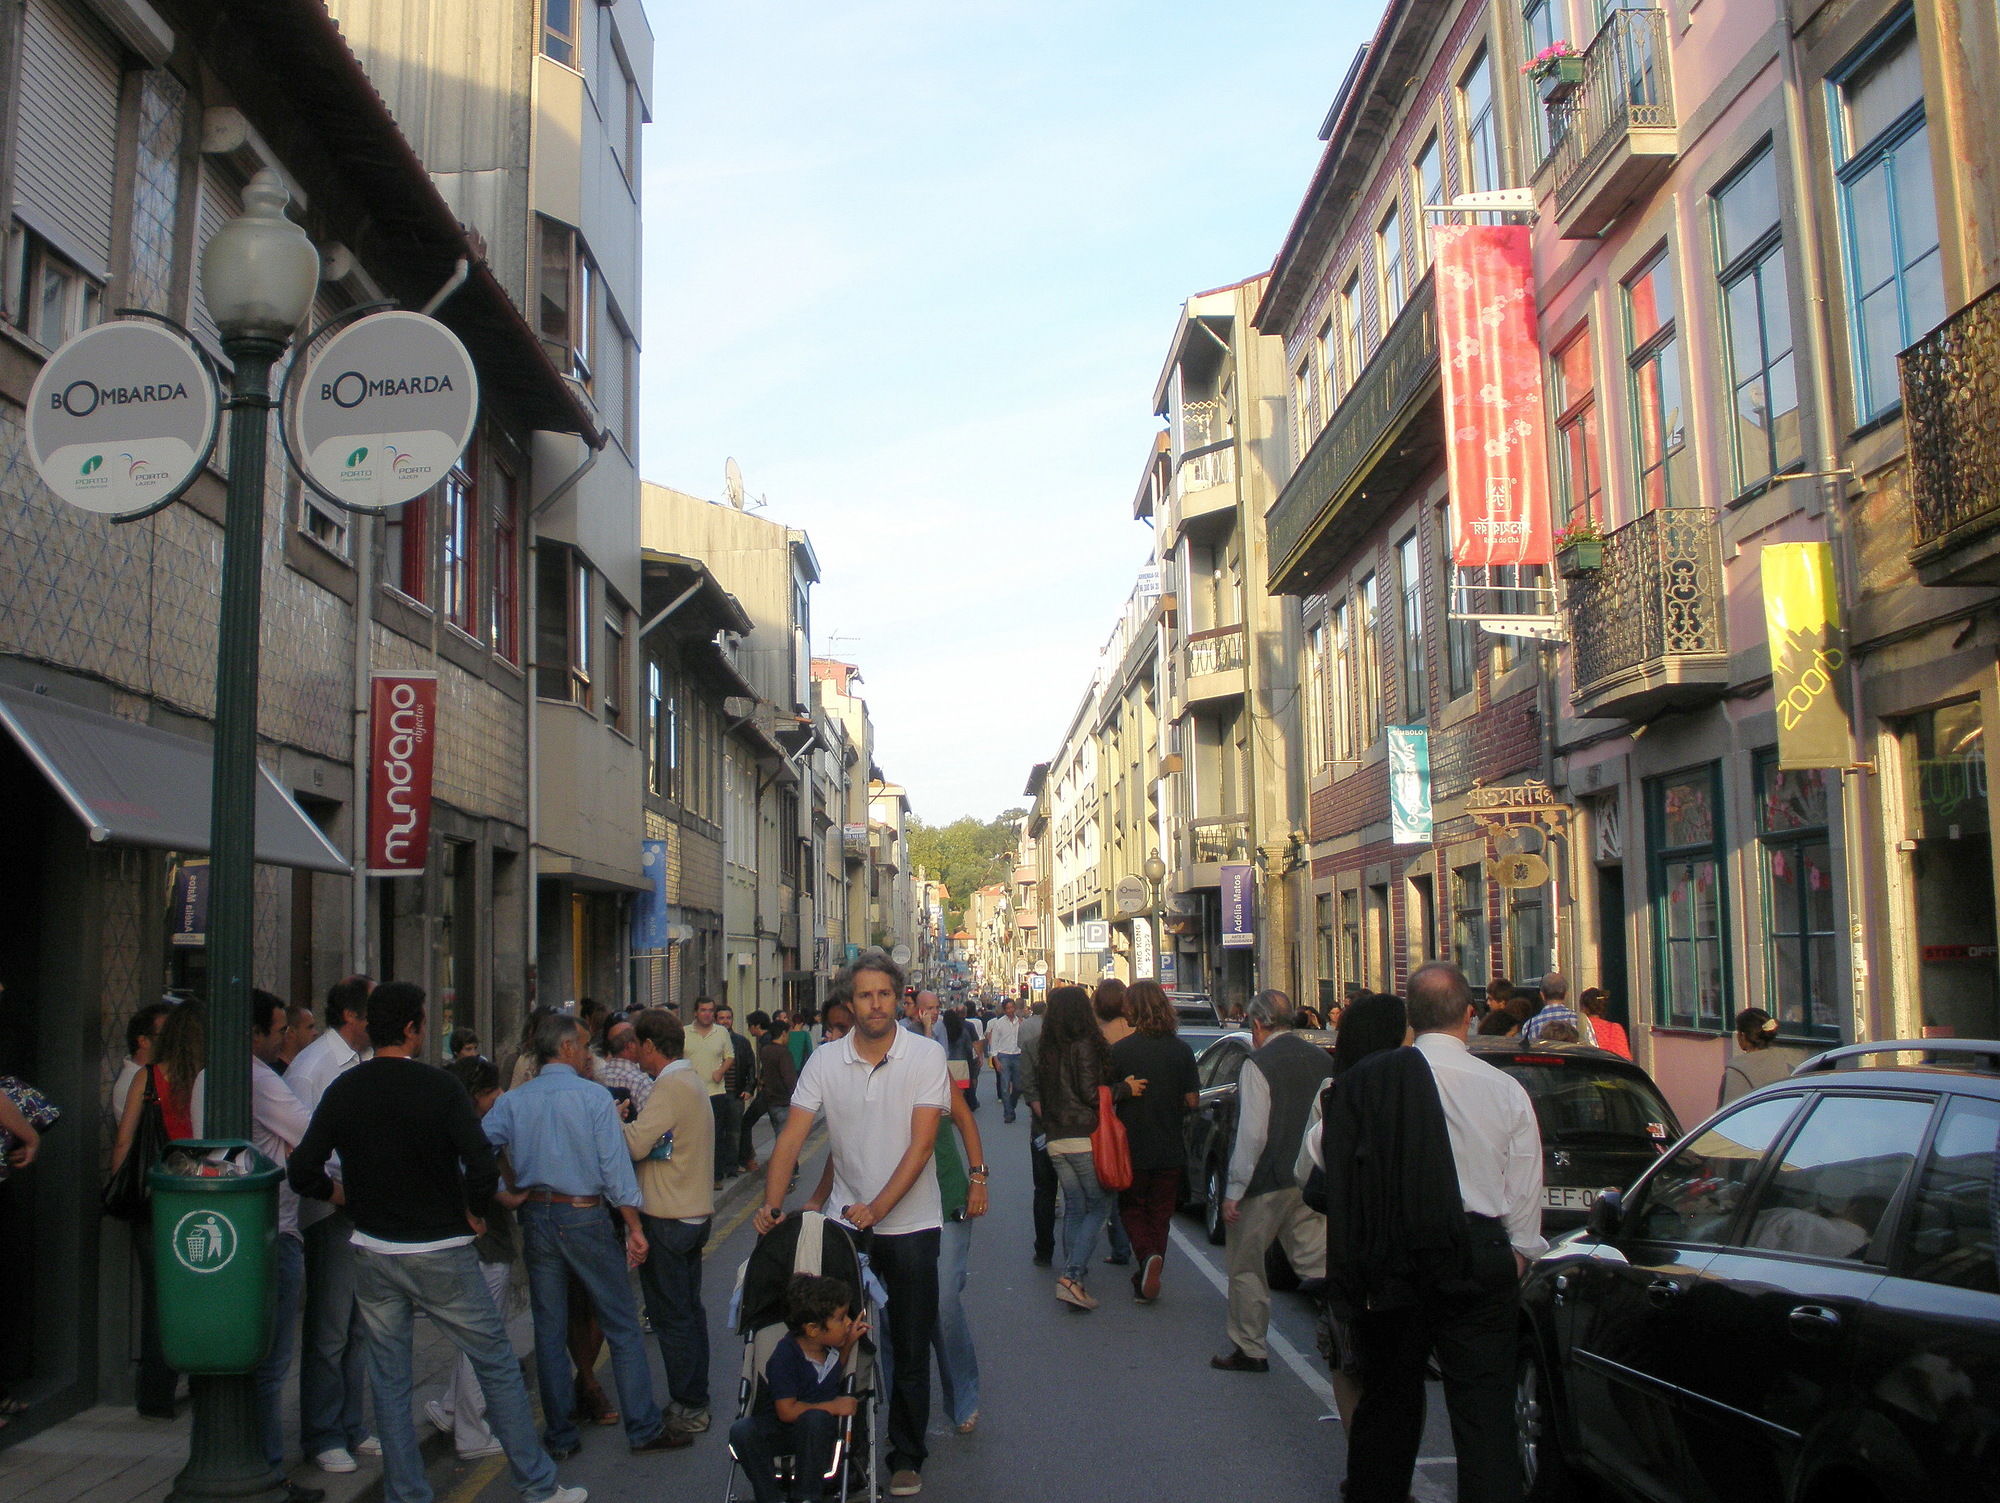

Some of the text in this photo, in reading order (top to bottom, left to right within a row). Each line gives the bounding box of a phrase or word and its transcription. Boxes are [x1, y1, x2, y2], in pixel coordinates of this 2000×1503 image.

[51, 380, 188, 417] BOMBARDA
[321, 371, 453, 408] BOMBARDA
[135, 472, 169, 481] PORTO
[340, 470, 372, 478] PORTO
[399, 466, 431, 474] PORTO
[1776, 648, 1844, 731] zoorb
[415, 703, 427, 743] objectos
[385, 684, 417, 864] mundano
[1234, 874, 1242, 902] Matos
[1234, 904, 1242, 933] Adélia
[1161, 956, 1171, 968] P
